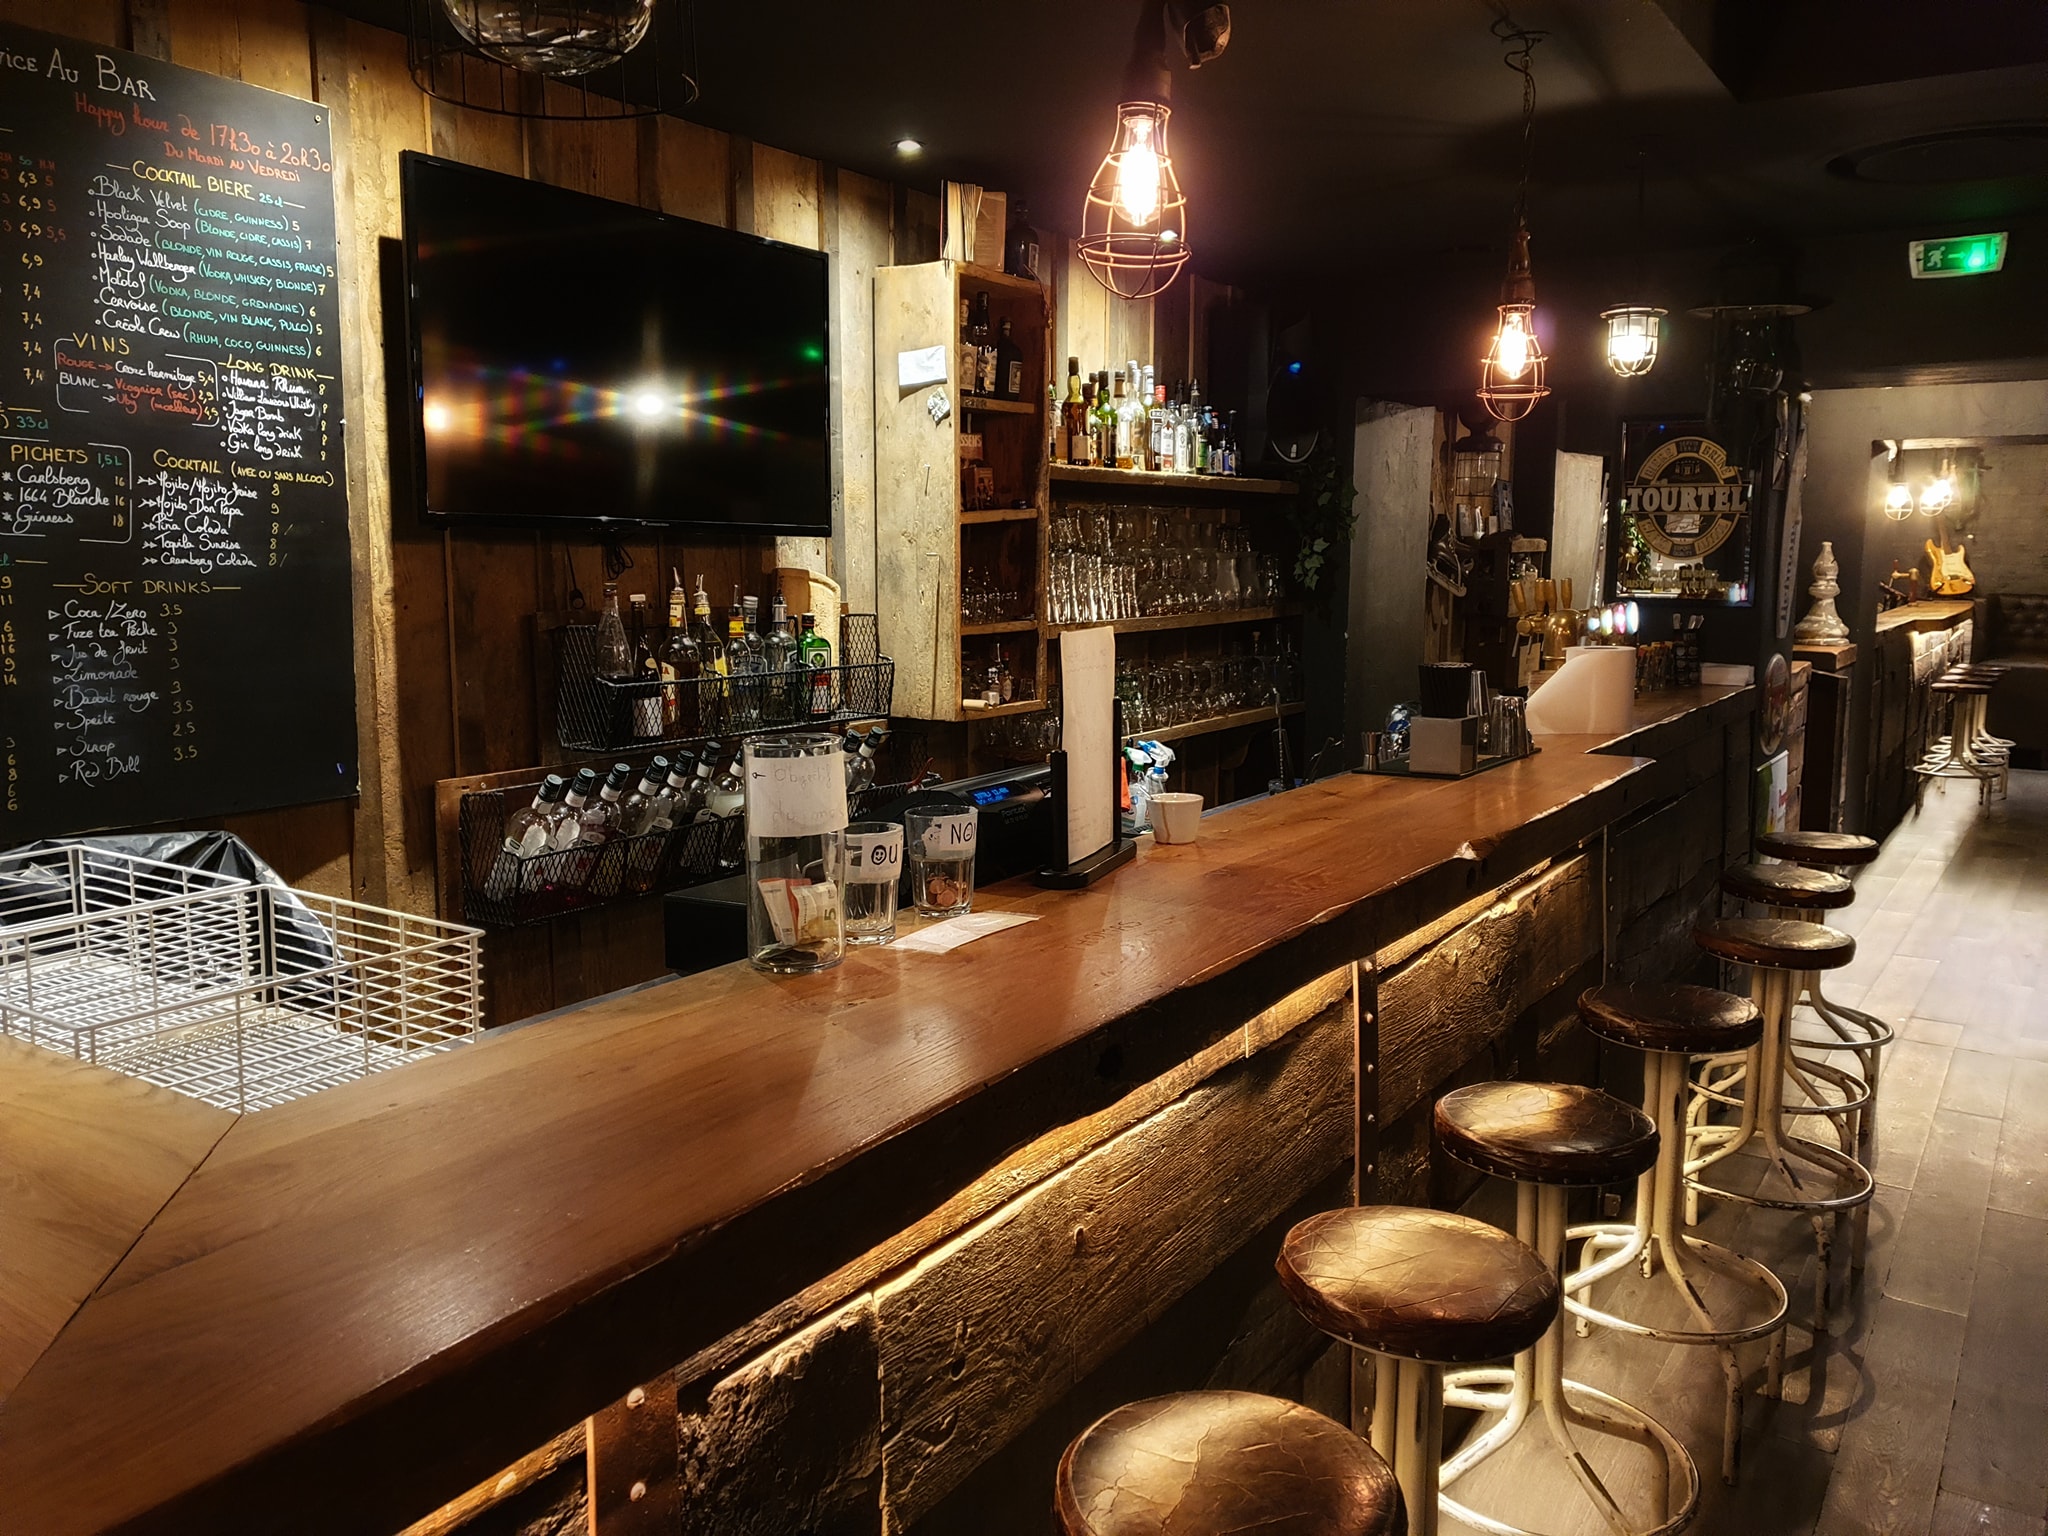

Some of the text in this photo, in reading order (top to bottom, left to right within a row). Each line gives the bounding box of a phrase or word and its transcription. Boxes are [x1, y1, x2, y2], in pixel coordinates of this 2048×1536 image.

[95, 54, 156, 101] BAR
[75, 91, 126, 136] Happy
[177, 113, 201, 141] de
[210, 123, 261, 156] 17h30
[279, 142, 331, 172] 20h30
[132, 160, 202, 190] COCKTAIL
[207, 176, 256, 201] BIERE
[93, 175, 145, 203] Black
[149, 189, 188, 212] Velvet
[292, 221, 300, 231] 5
[97, 199, 150, 232] Hooligan
[155, 208, 191, 240] Soop
[97, 241, 135, 272] Harley
[100, 223, 152, 247] Sodade
[205, 247, 222, 258] VIN
[326, 265, 334, 278] 5
[99, 286, 159, 313] Cervoise
[219, 313, 238, 323] VIN
[316, 324, 323, 335] 5
[309, 306, 316, 317] 6
[72, 332, 130, 355] VINS
[148, 316, 181, 339] Crew
[315, 346, 322, 356] 6
[57, 351, 97, 370] ROUGE
[226, 353, 318, 382] LONG DRINK
[59, 371, 99, 388] BLANC
[10, 444, 89, 464] PICHETS
[227, 433, 250, 454] Gin
[153, 449, 222, 474] COCKTAIL
[17, 464, 125, 495] Carlsberg 16
[20, 486, 125, 508] 1664 Blanche 16
[1627, 486, 1748, 513] TOURTEL
[112, 514, 124, 527] 18
[155, 495, 188, 517] Mojito
[188, 497, 216, 515] Don
[214, 497, 244, 528] Papa
[184, 515, 229, 535] Colada
[154, 531, 195, 556] Tequila
[199, 533, 241, 551] Sunrise
[216, 552, 257, 567] Colada
[79, 573, 211, 595] SOFT DRINKS
[160, 603, 183, 617] 3.5
[62, 621, 94, 639] Fuze
[167, 621, 178, 635] 3
[61, 643, 88, 668] Jus
[88, 642, 108, 658] de
[168, 638, 178, 651] 3
[64, 660, 140, 682] Limonade
[123, 691, 160, 713] rouge
[66, 708, 116, 736] Sprite
[70, 760, 100, 788] Red
[103, 755, 141, 780] Bull
